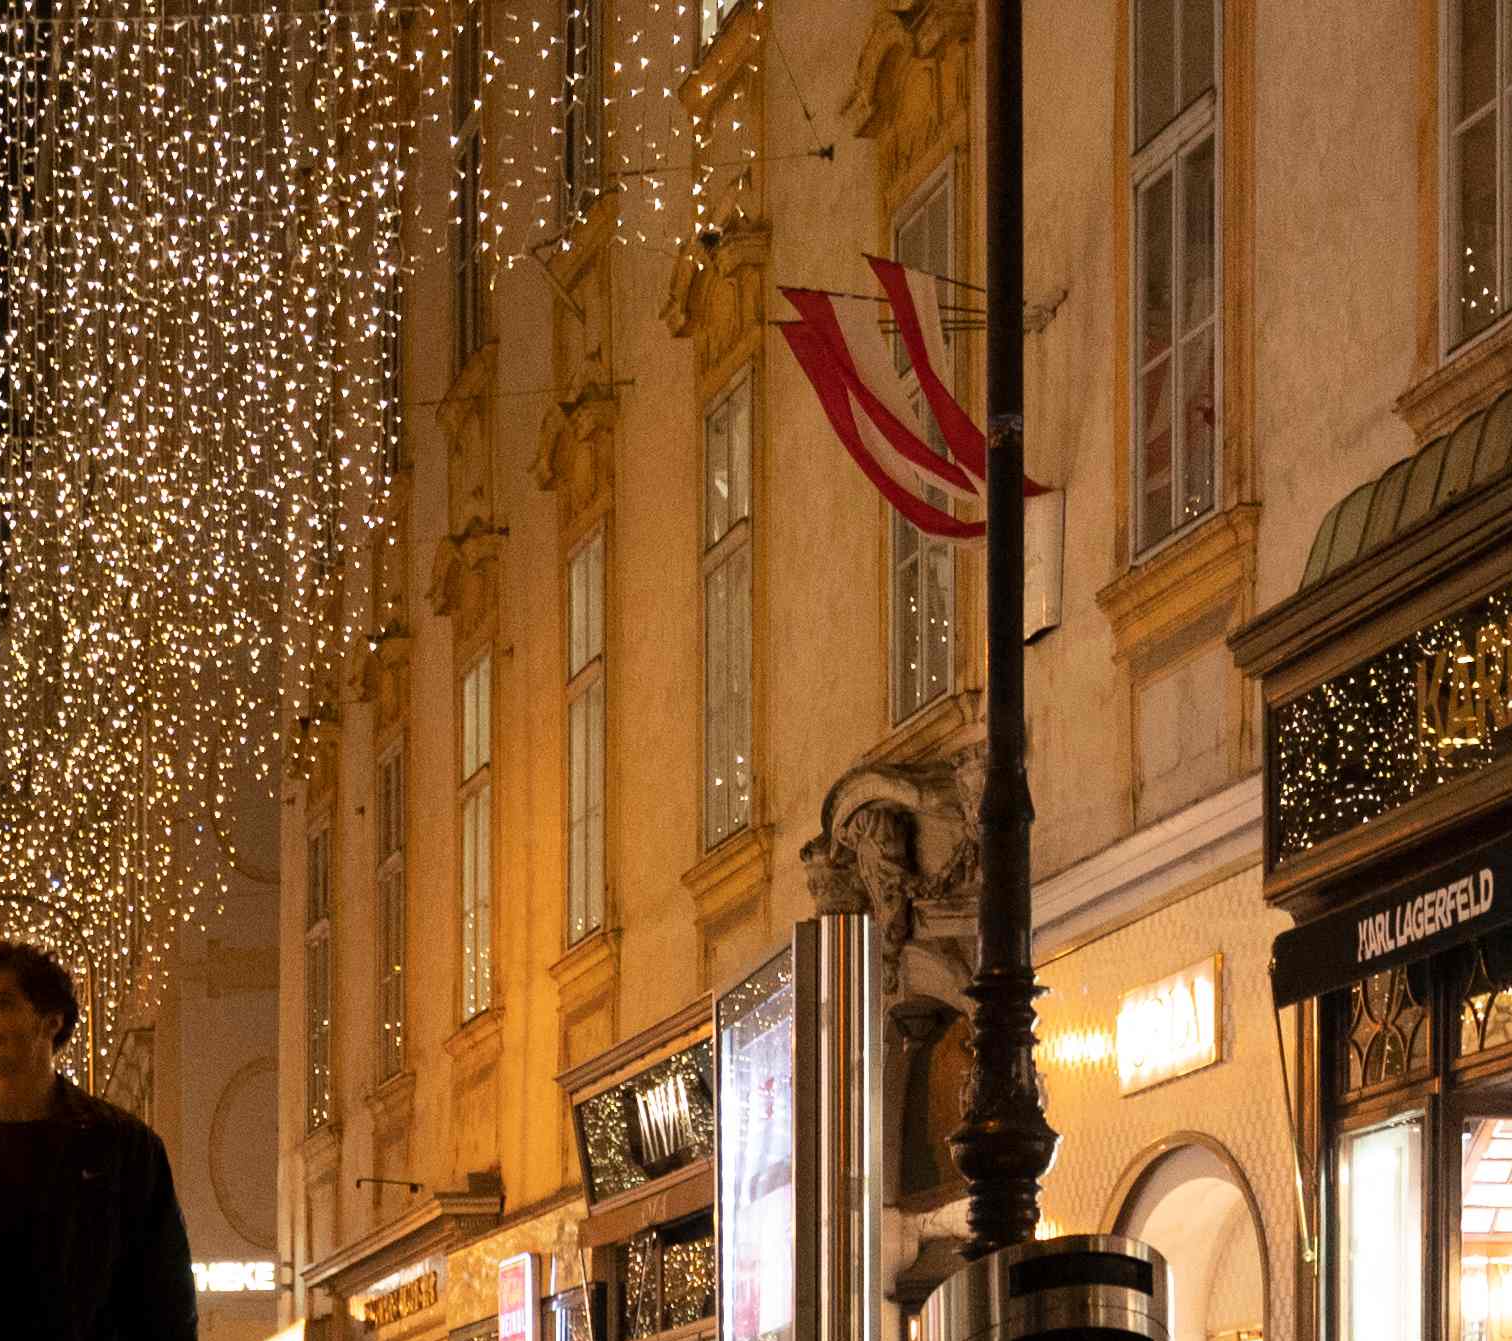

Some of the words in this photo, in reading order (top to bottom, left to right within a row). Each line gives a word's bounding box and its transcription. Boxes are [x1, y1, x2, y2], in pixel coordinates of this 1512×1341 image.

[1357, 911, 1396, 963] KARL
[1396, 867, 1494, 954] LAGERFELD
[190, 1262, 276, 1292] THEKE
